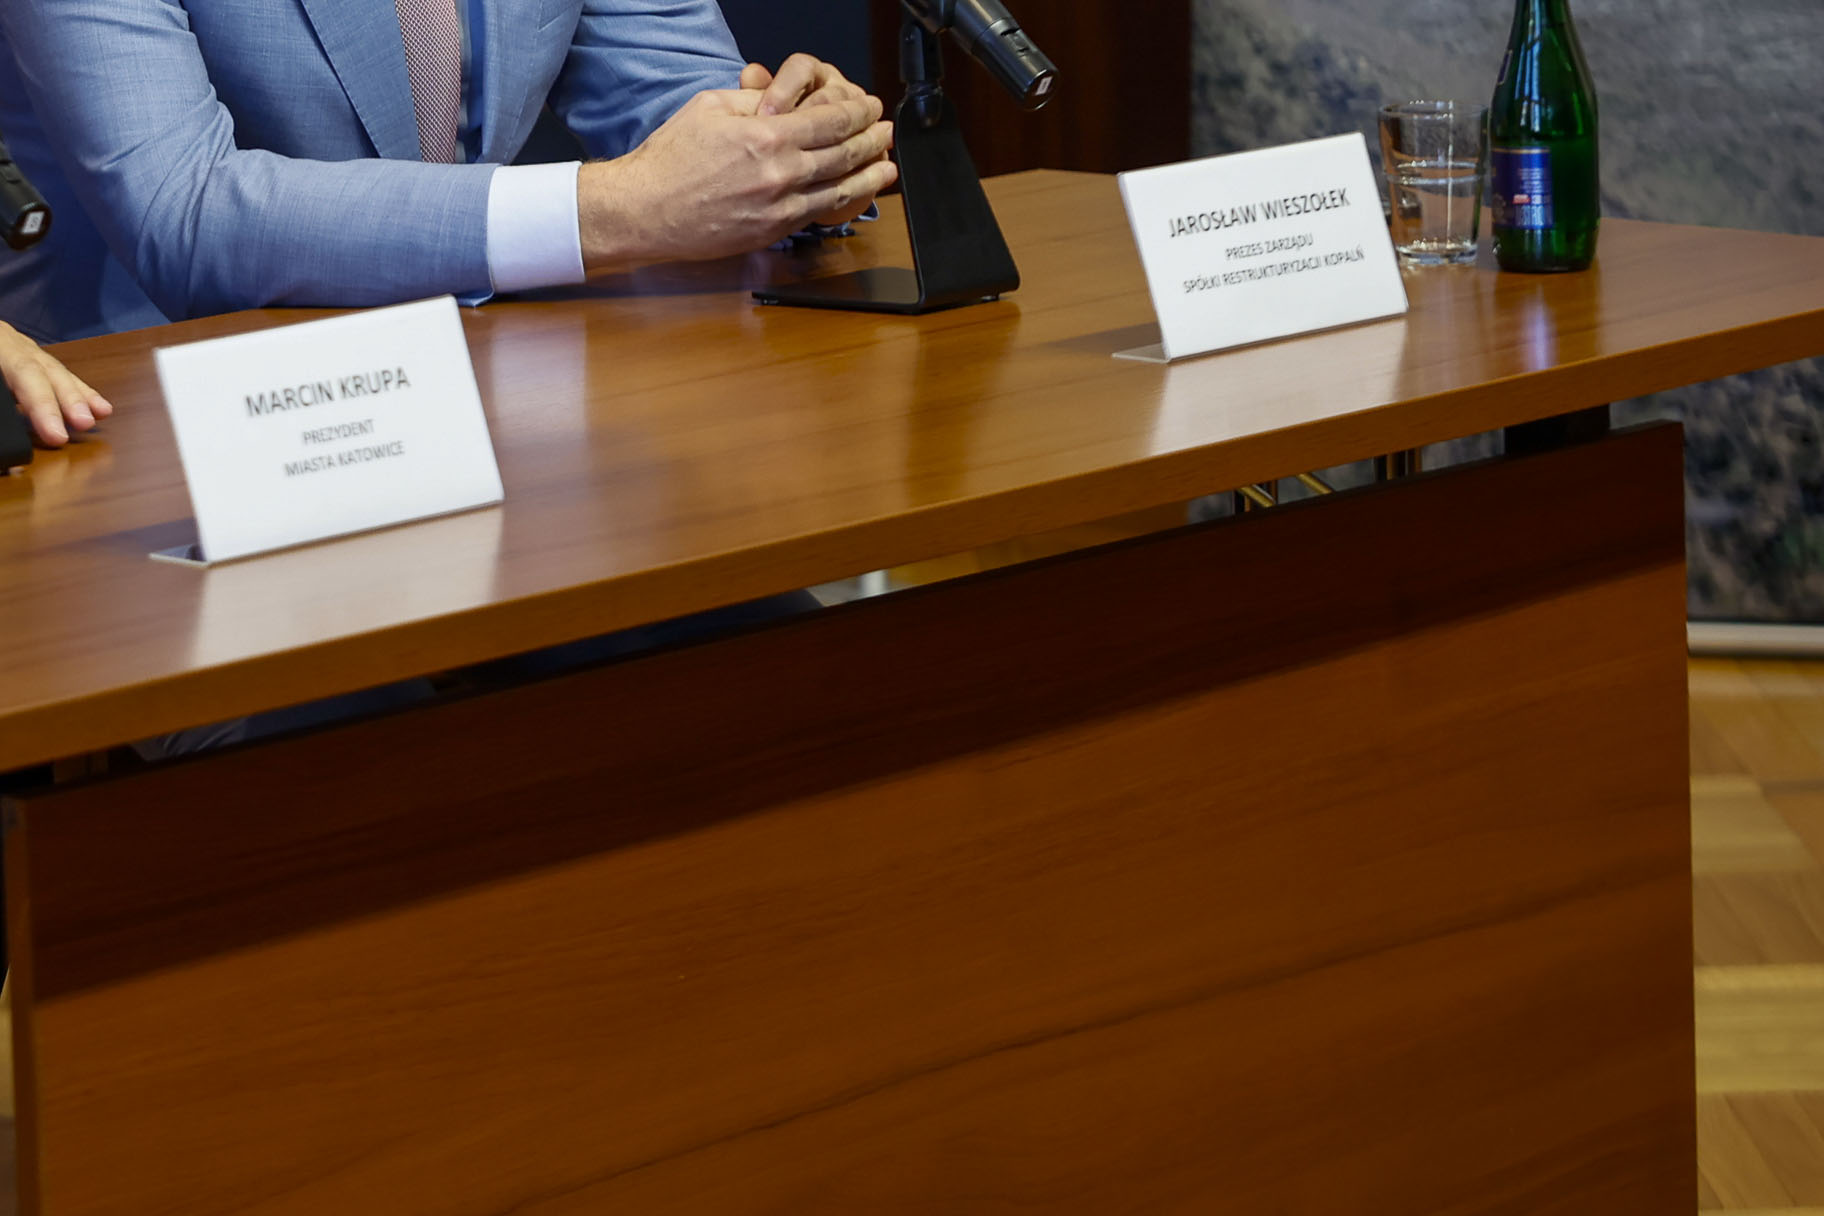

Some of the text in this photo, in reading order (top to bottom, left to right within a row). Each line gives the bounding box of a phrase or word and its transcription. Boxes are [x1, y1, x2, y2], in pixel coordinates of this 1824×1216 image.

[1169, 188, 1350, 238] JAROSŁAW WIESZOŁEK
[1225, 232, 1314, 260] PREZES ZARZĄDU
[1183, 274, 1222, 294] SPÓŁKI
[1323, 243, 1365, 267] KOPALŃ
[245, 367, 411, 417] MARCIN KRUPA
[303, 418, 375, 446] PREZYDENT
[285, 440, 405, 477] MIASTA KATOWICE
